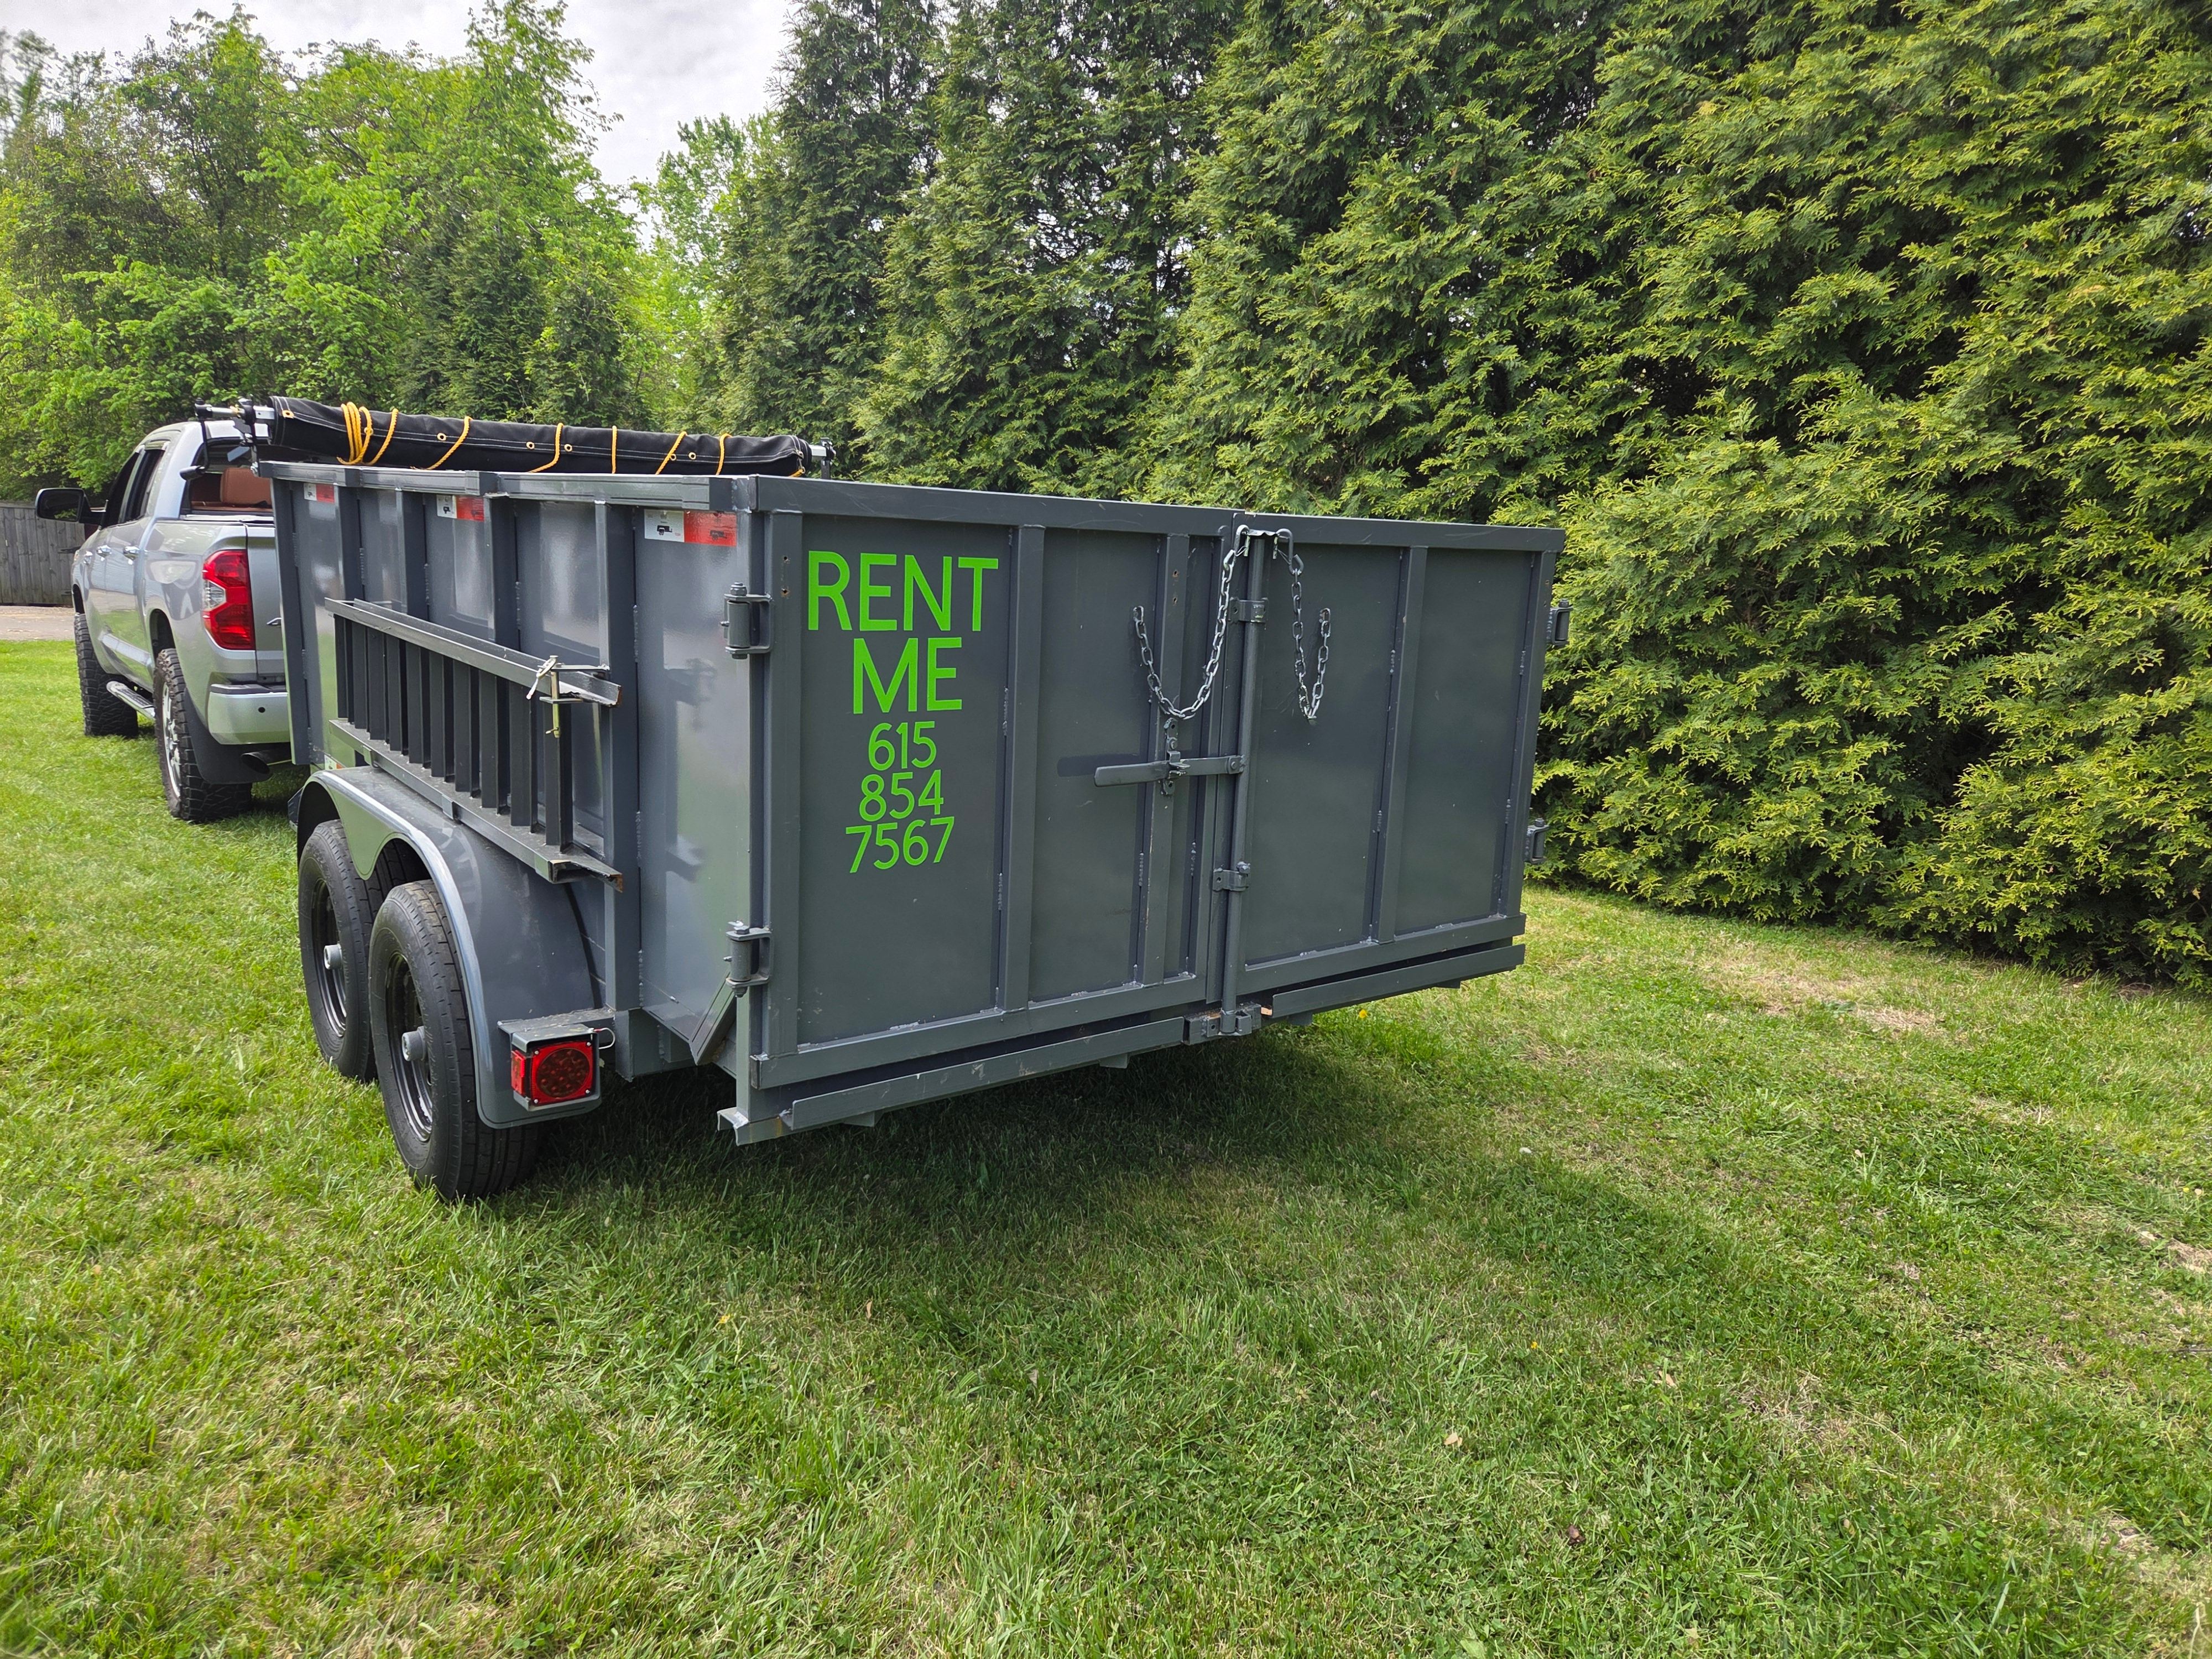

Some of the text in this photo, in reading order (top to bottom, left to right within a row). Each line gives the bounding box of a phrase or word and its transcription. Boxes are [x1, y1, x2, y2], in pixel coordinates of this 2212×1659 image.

[808, 550, 998, 632] RENT
[853, 637, 963, 714] ME
[868, 721, 937, 770] 615
[859, 769, 944, 822] 854
[846, 816, 955, 873] 7567
